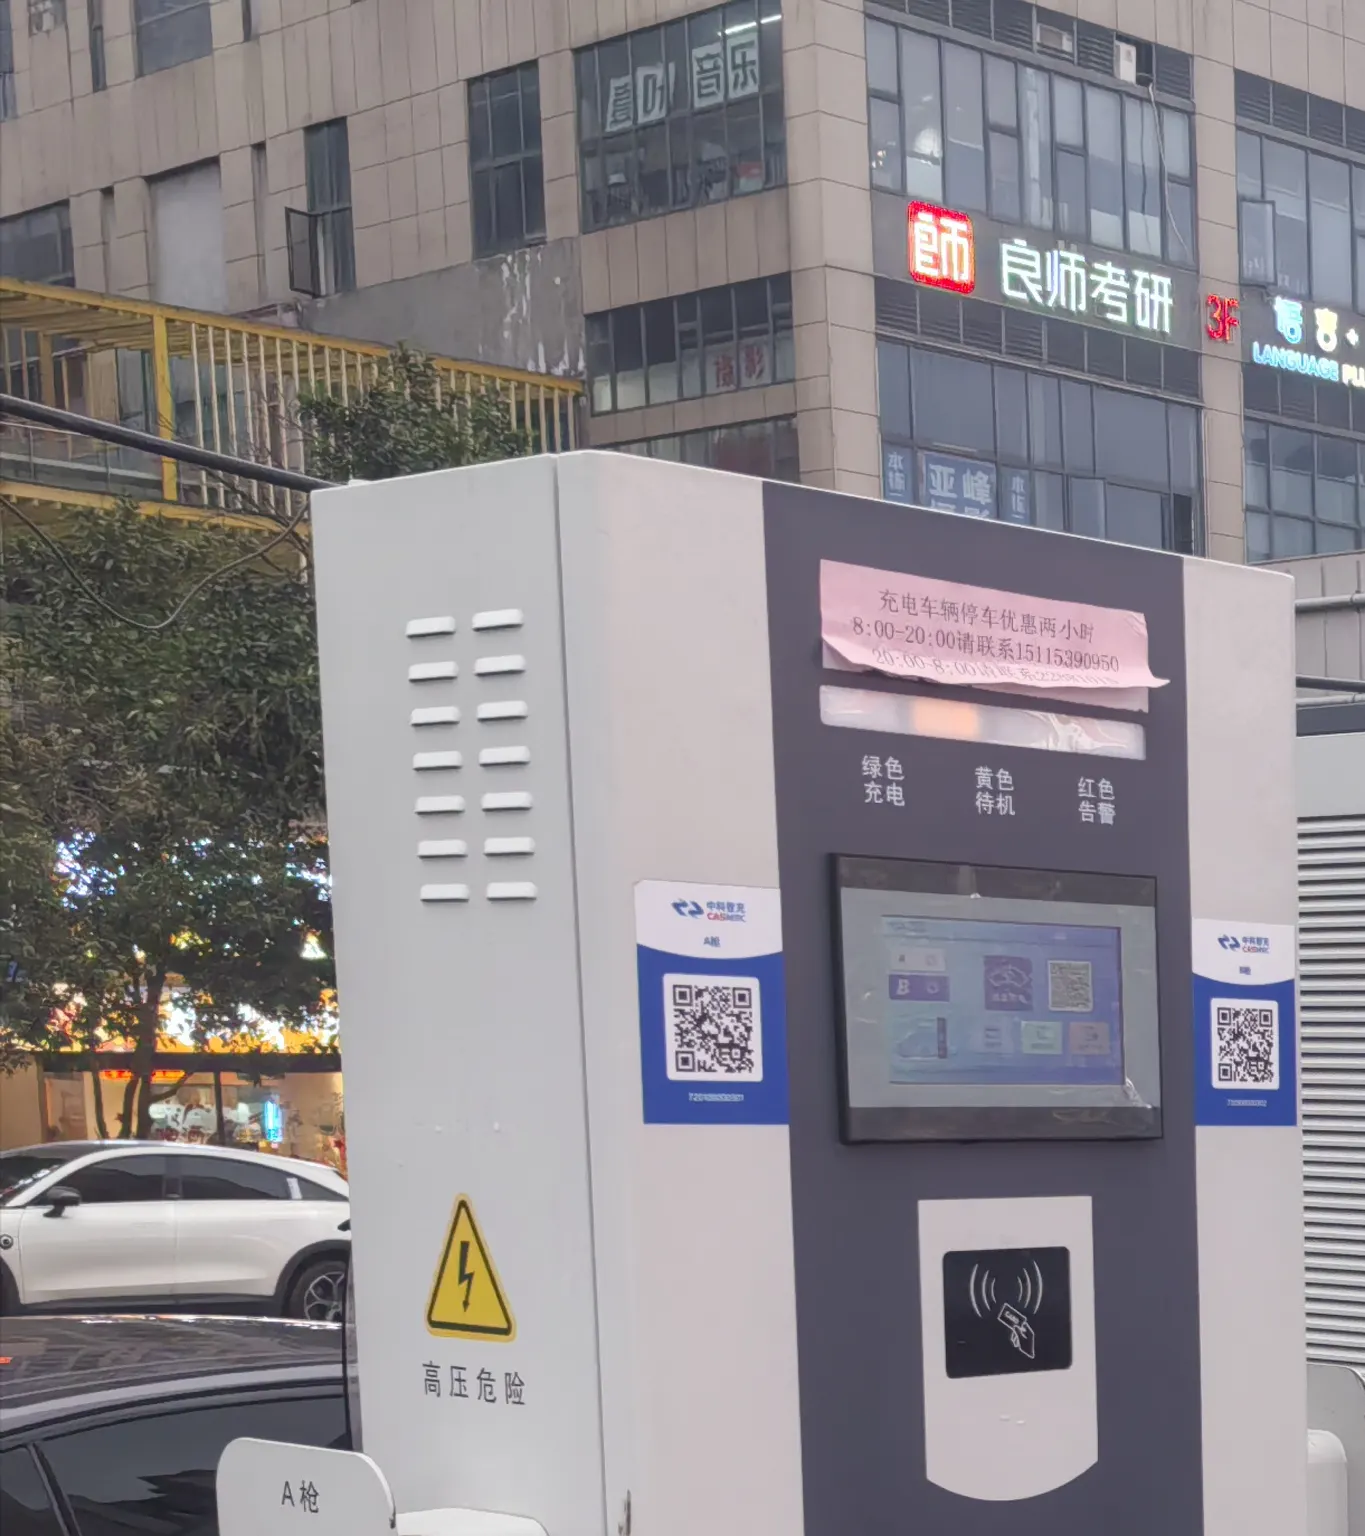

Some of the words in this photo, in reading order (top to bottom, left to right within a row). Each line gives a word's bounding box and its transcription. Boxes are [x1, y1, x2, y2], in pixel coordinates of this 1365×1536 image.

[1000, 238, 1174, 334] 良师考研
[1207, 294, 1239, 342] 3F
[1252, 340, 1339, 382] LANGUAGE
[879, 588, 1095, 643] 充电车辆停车优惠两小时
[862, 755, 905, 781] 绿色
[975, 765, 1014, 792] 黄色
[1078, 777, 1115, 801] 红色
[864, 781, 905, 807] 充电
[975, 791, 1016, 816] 待机
[1078, 801, 1116, 826] 告警
[421, 1360, 526, 1405] 高压危险
